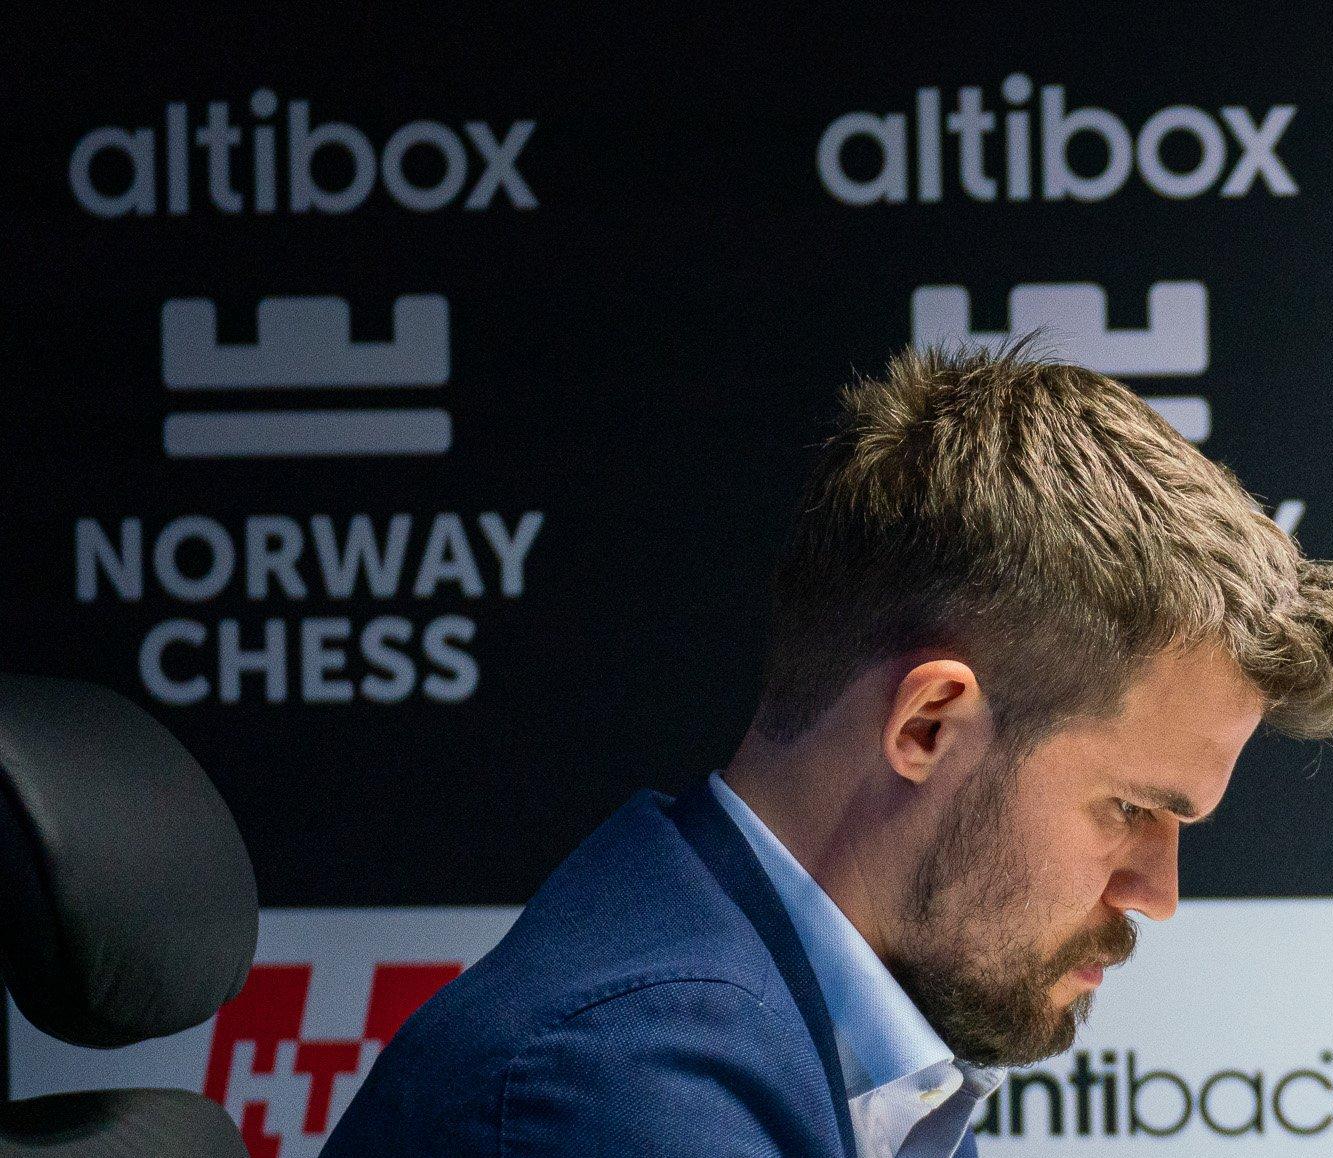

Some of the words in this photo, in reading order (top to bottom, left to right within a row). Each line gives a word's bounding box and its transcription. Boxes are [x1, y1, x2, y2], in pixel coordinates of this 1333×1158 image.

[69, 88, 538, 217] altibox
[817, 73, 1299, 205] altibox
[75, 512, 544, 600] NORWAY
[139, 615, 480, 703] CHESS
